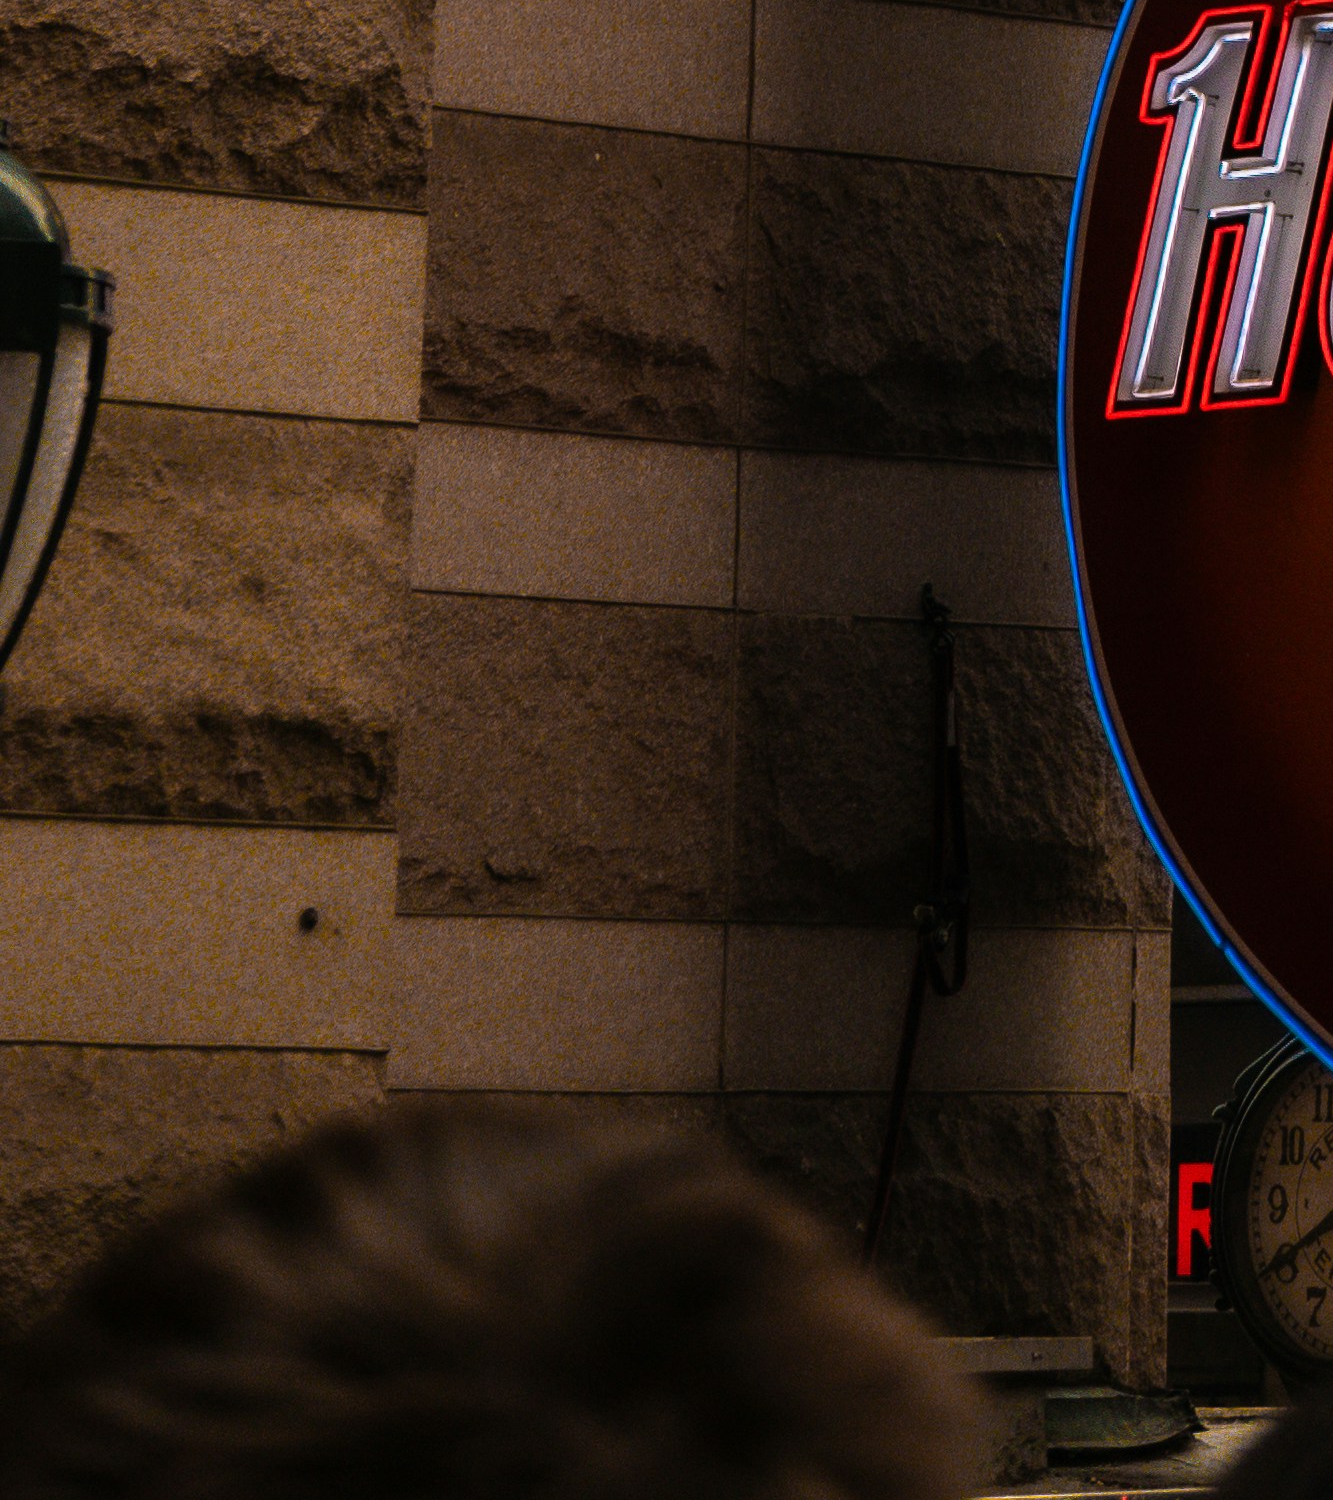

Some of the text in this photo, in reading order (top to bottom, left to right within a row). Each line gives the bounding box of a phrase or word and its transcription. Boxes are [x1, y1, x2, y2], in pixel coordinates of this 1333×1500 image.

[1278, 1125, 1305, 1166] 10
[1267, 1184, 1289, 1224] 9
[1306, 1287, 1327, 1328] 7
